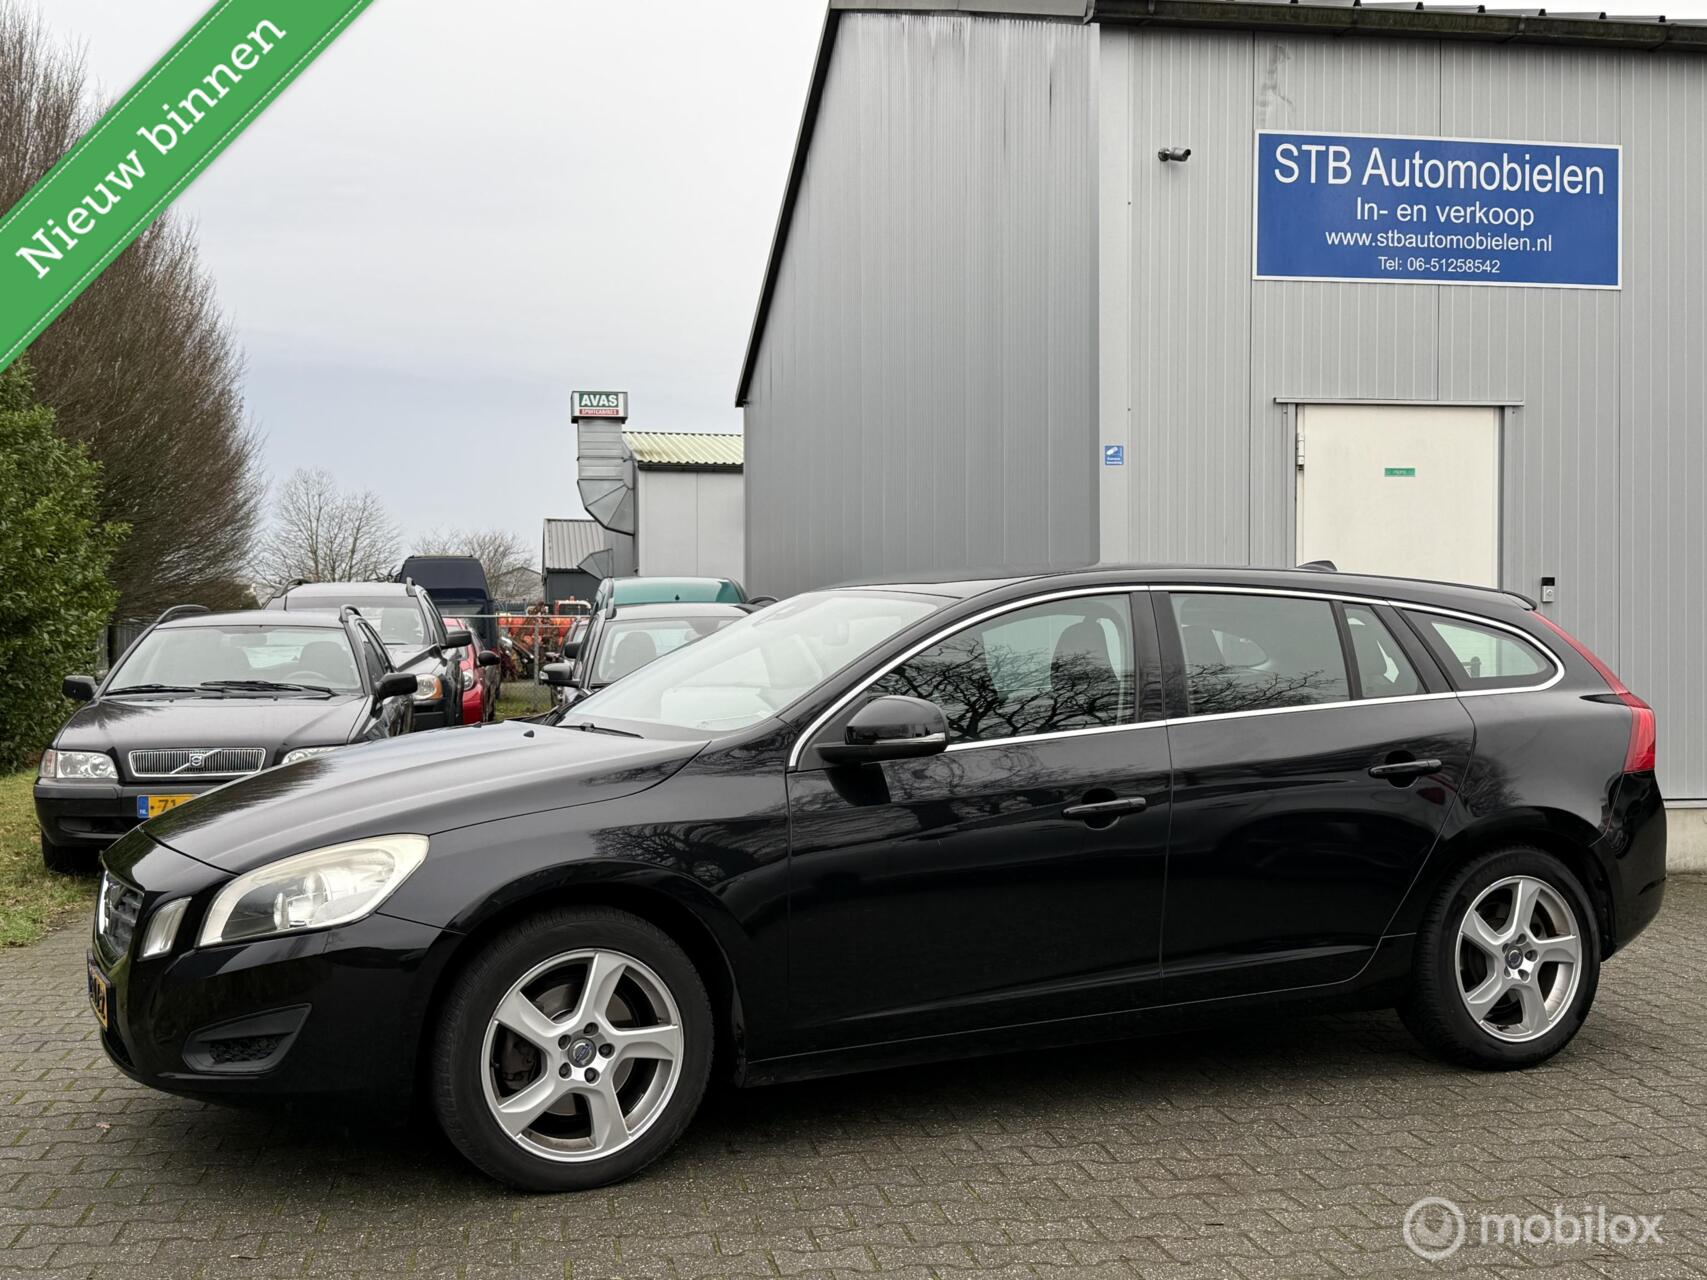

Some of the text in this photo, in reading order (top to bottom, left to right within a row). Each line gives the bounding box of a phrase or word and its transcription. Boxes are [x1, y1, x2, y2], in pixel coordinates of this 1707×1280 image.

[1274, 143, 1604, 195] STB Automobielen
[1356, 197, 1535, 231] In- en verkoop
[1325, 229, 1552, 252] www.stbautomobielen.nl
[1378, 256, 1501, 273] Tel: 06-51258542
[581, 394, 618, 407] AVAS
